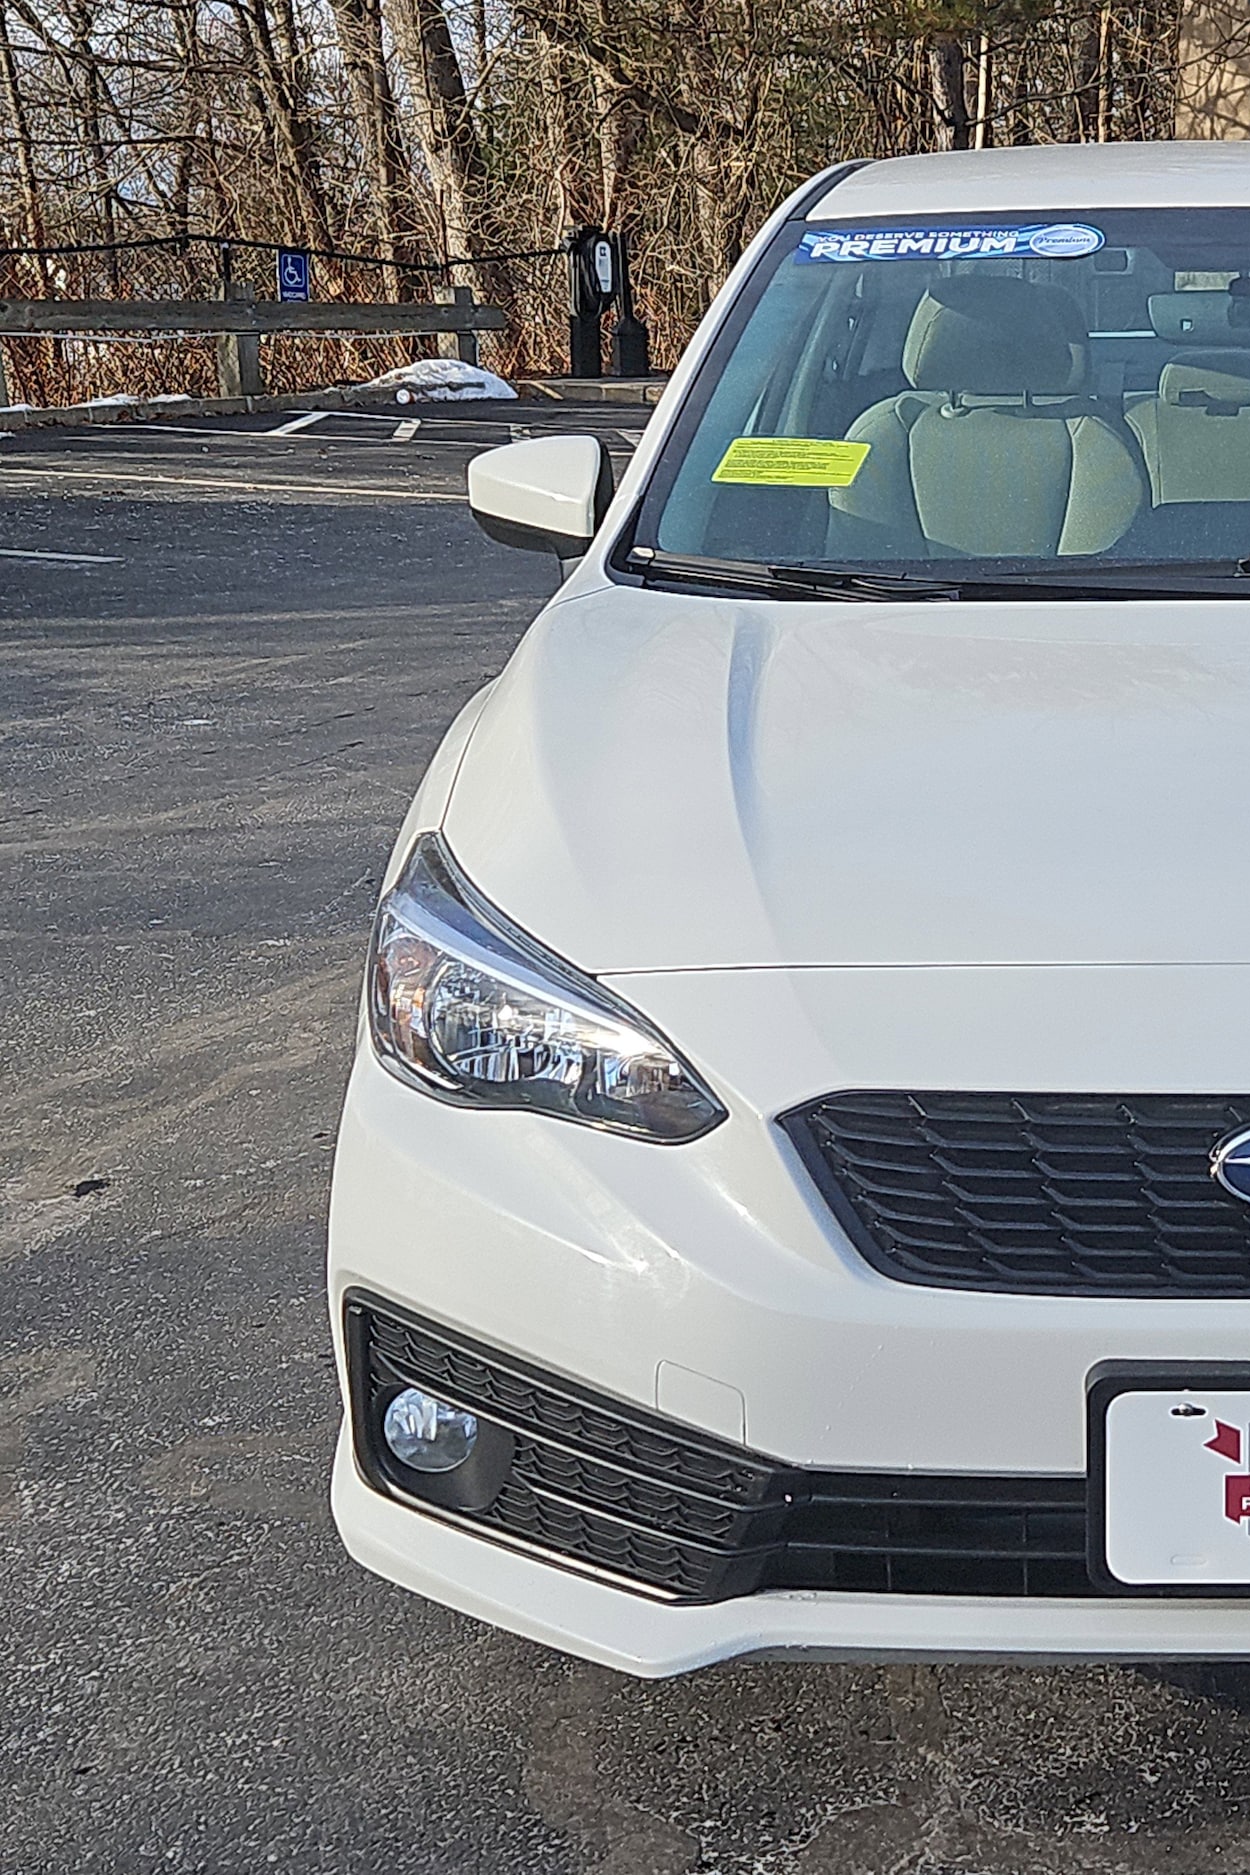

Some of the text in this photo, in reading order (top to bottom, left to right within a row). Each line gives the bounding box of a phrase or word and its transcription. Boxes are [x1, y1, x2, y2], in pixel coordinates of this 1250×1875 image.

[818, 230, 1020, 242] YOU DESERVE SOMETHING
[810, 237, 1017, 258] PREMIUM
